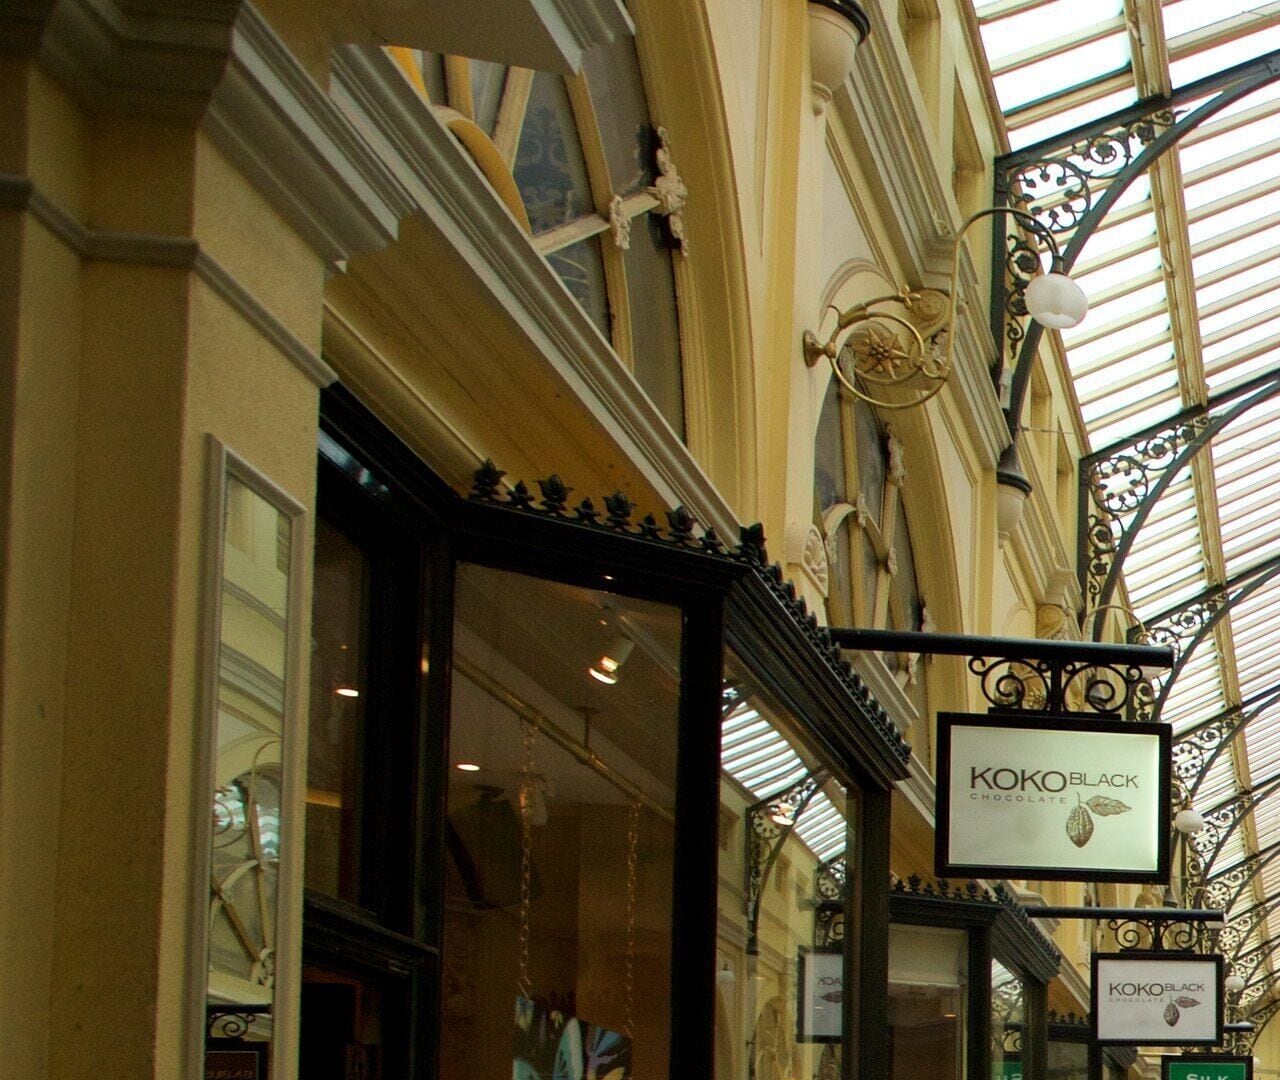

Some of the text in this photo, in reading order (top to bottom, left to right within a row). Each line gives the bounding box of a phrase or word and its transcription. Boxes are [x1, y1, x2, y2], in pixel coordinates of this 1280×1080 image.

[970, 766, 1139, 792] KOKO BLACK
[970, 793, 1067, 804] CHOCOLATE
[1109, 983, 1205, 996] KOKO BLACK
